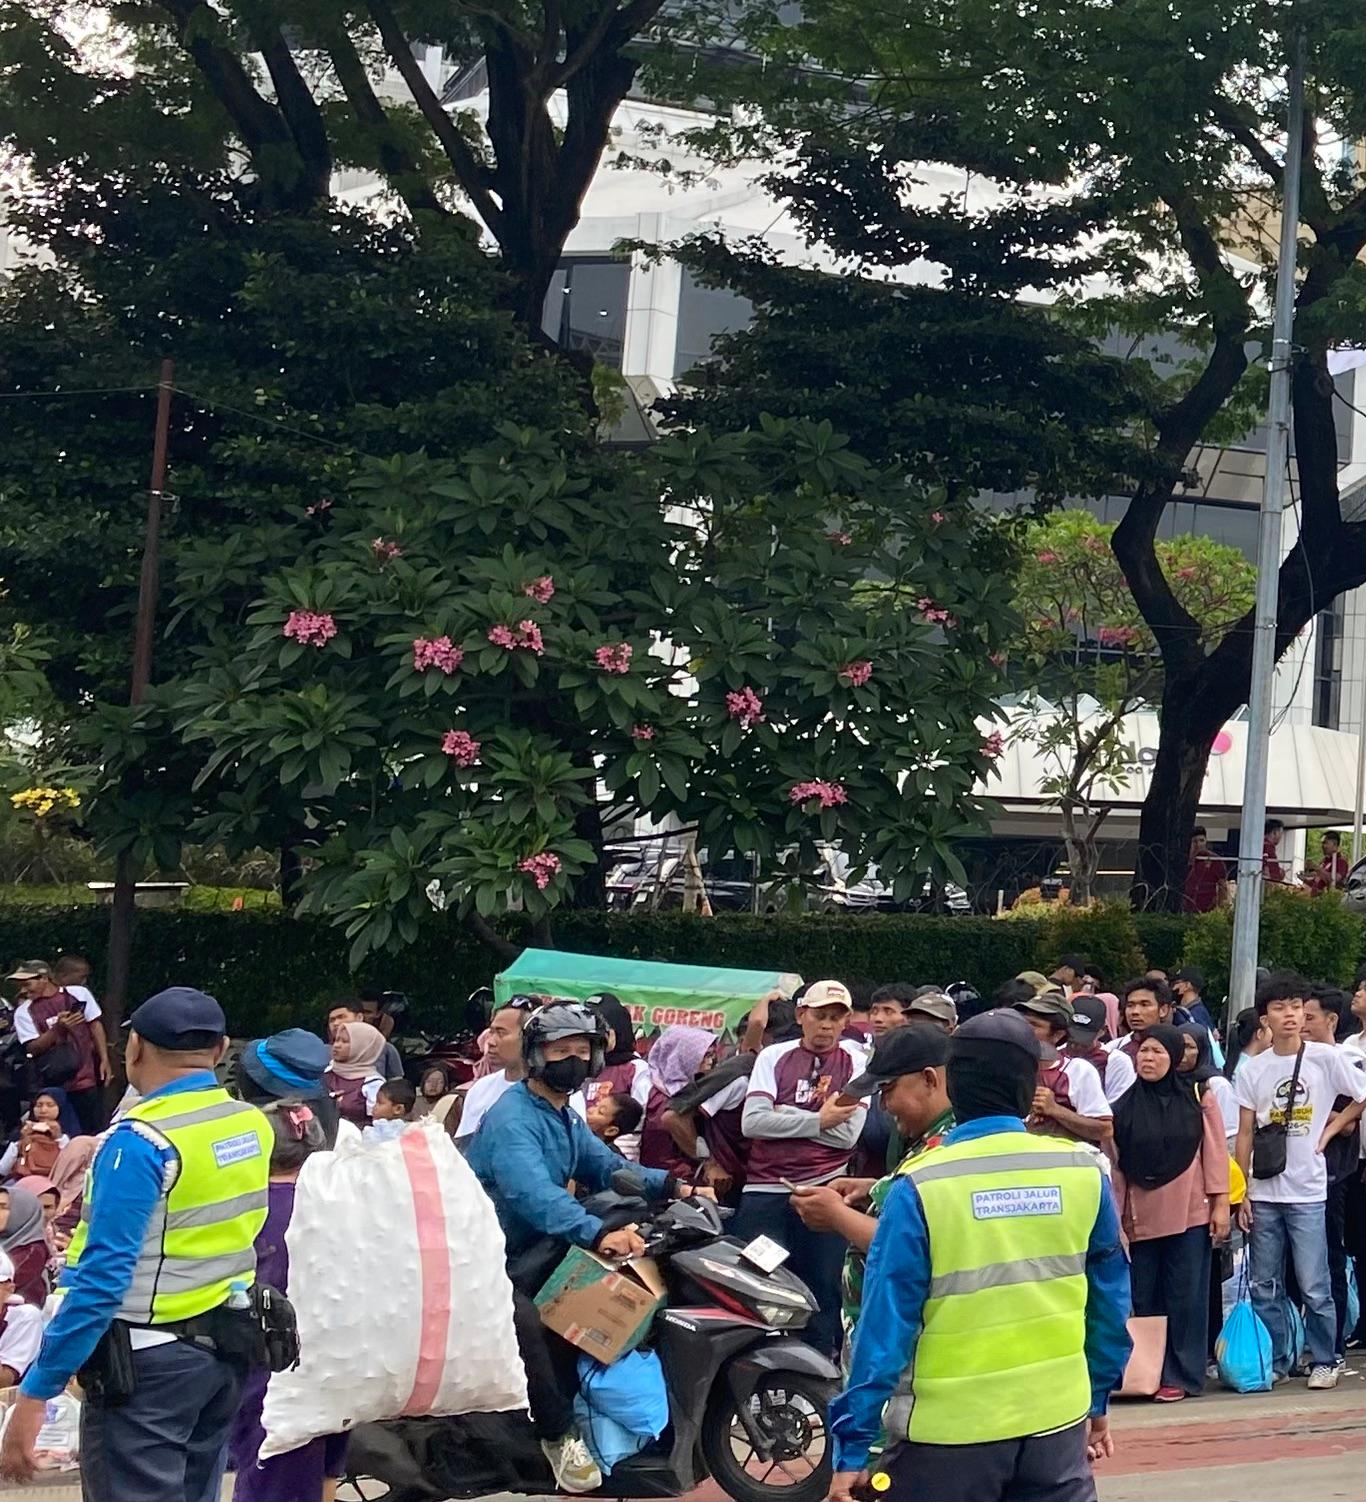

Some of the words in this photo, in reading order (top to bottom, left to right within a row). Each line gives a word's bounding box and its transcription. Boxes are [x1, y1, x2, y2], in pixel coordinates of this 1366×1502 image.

[651, 1007, 725, 1028] GORENG
[975, 1191, 1021, 1204] PATROLI
[1023, 1188, 1058, 1199] JALUR
[975, 1201, 1060, 1215] TRANSJAKARTA
[665, 1314, 697, 1333] HONDA
